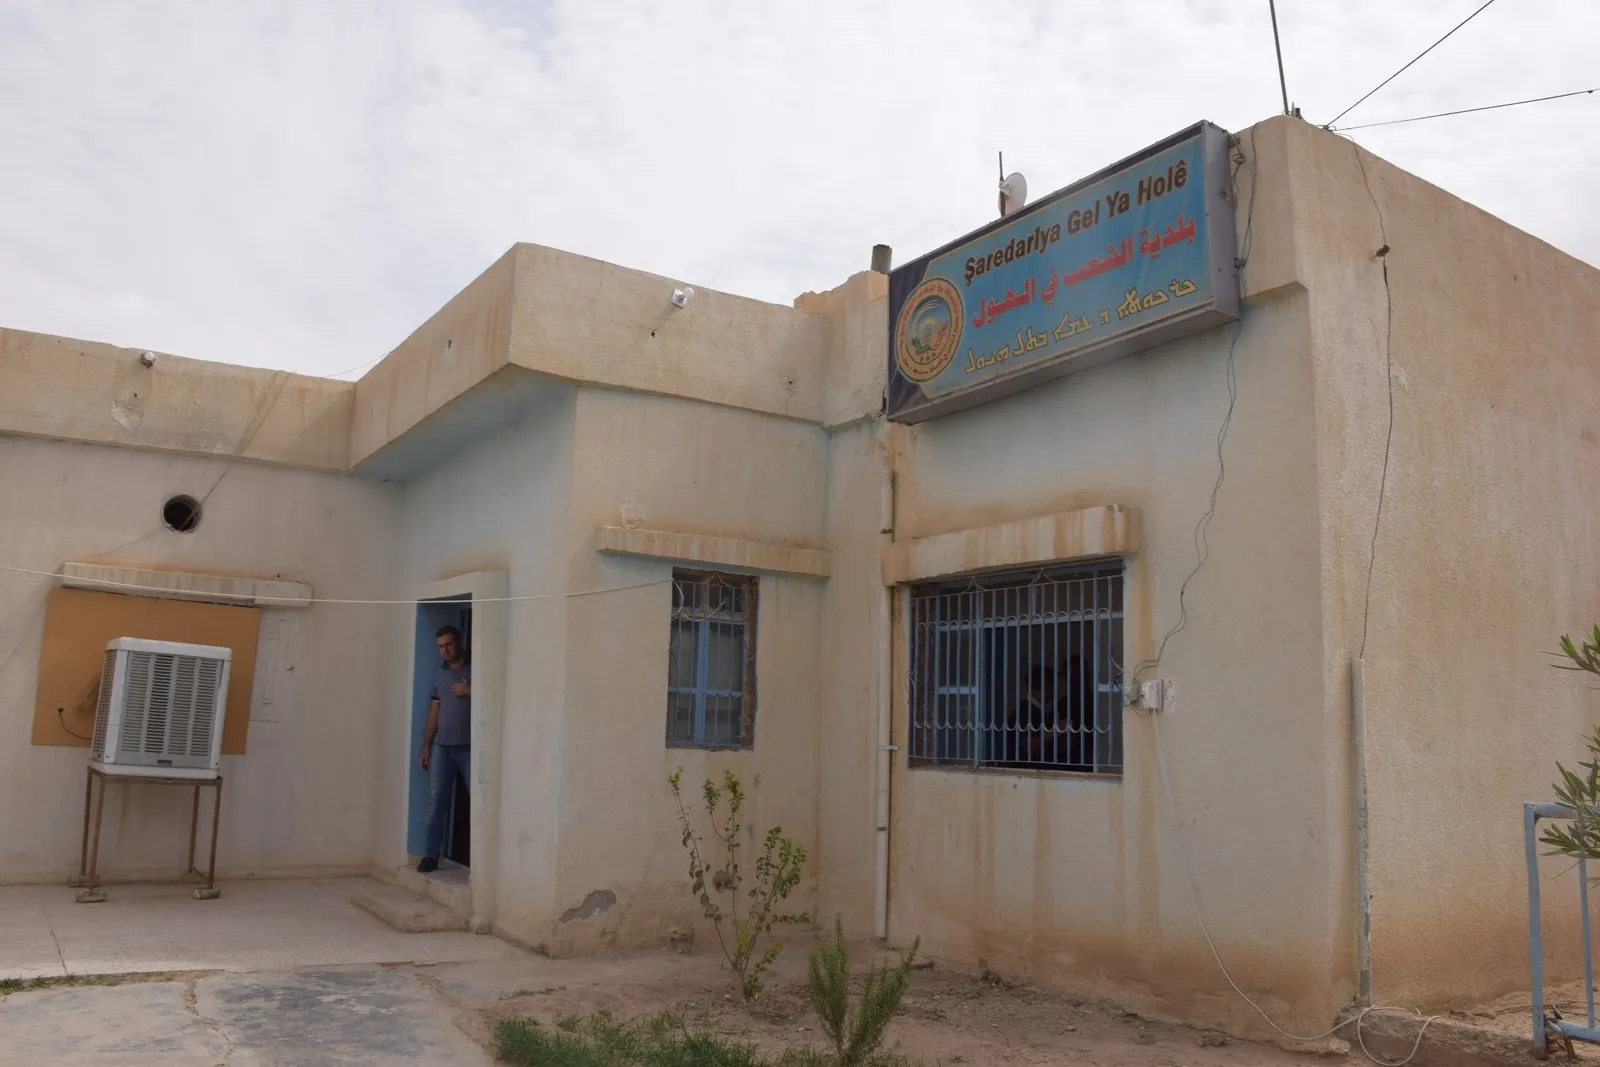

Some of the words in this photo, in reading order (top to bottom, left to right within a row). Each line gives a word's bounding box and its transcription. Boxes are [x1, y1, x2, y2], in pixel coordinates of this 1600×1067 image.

[1067, 200, 1100, 236] Gel
[1105, 190, 1131, 218] Ya
[1137, 159, 1188, 206] Holê
[1063, 236, 1134, 287] الشعب
[1138, 214, 1196, 260] بلدية
[972, 275, 1036, 328] الهول
[1040, 265, 1060, 308] في
